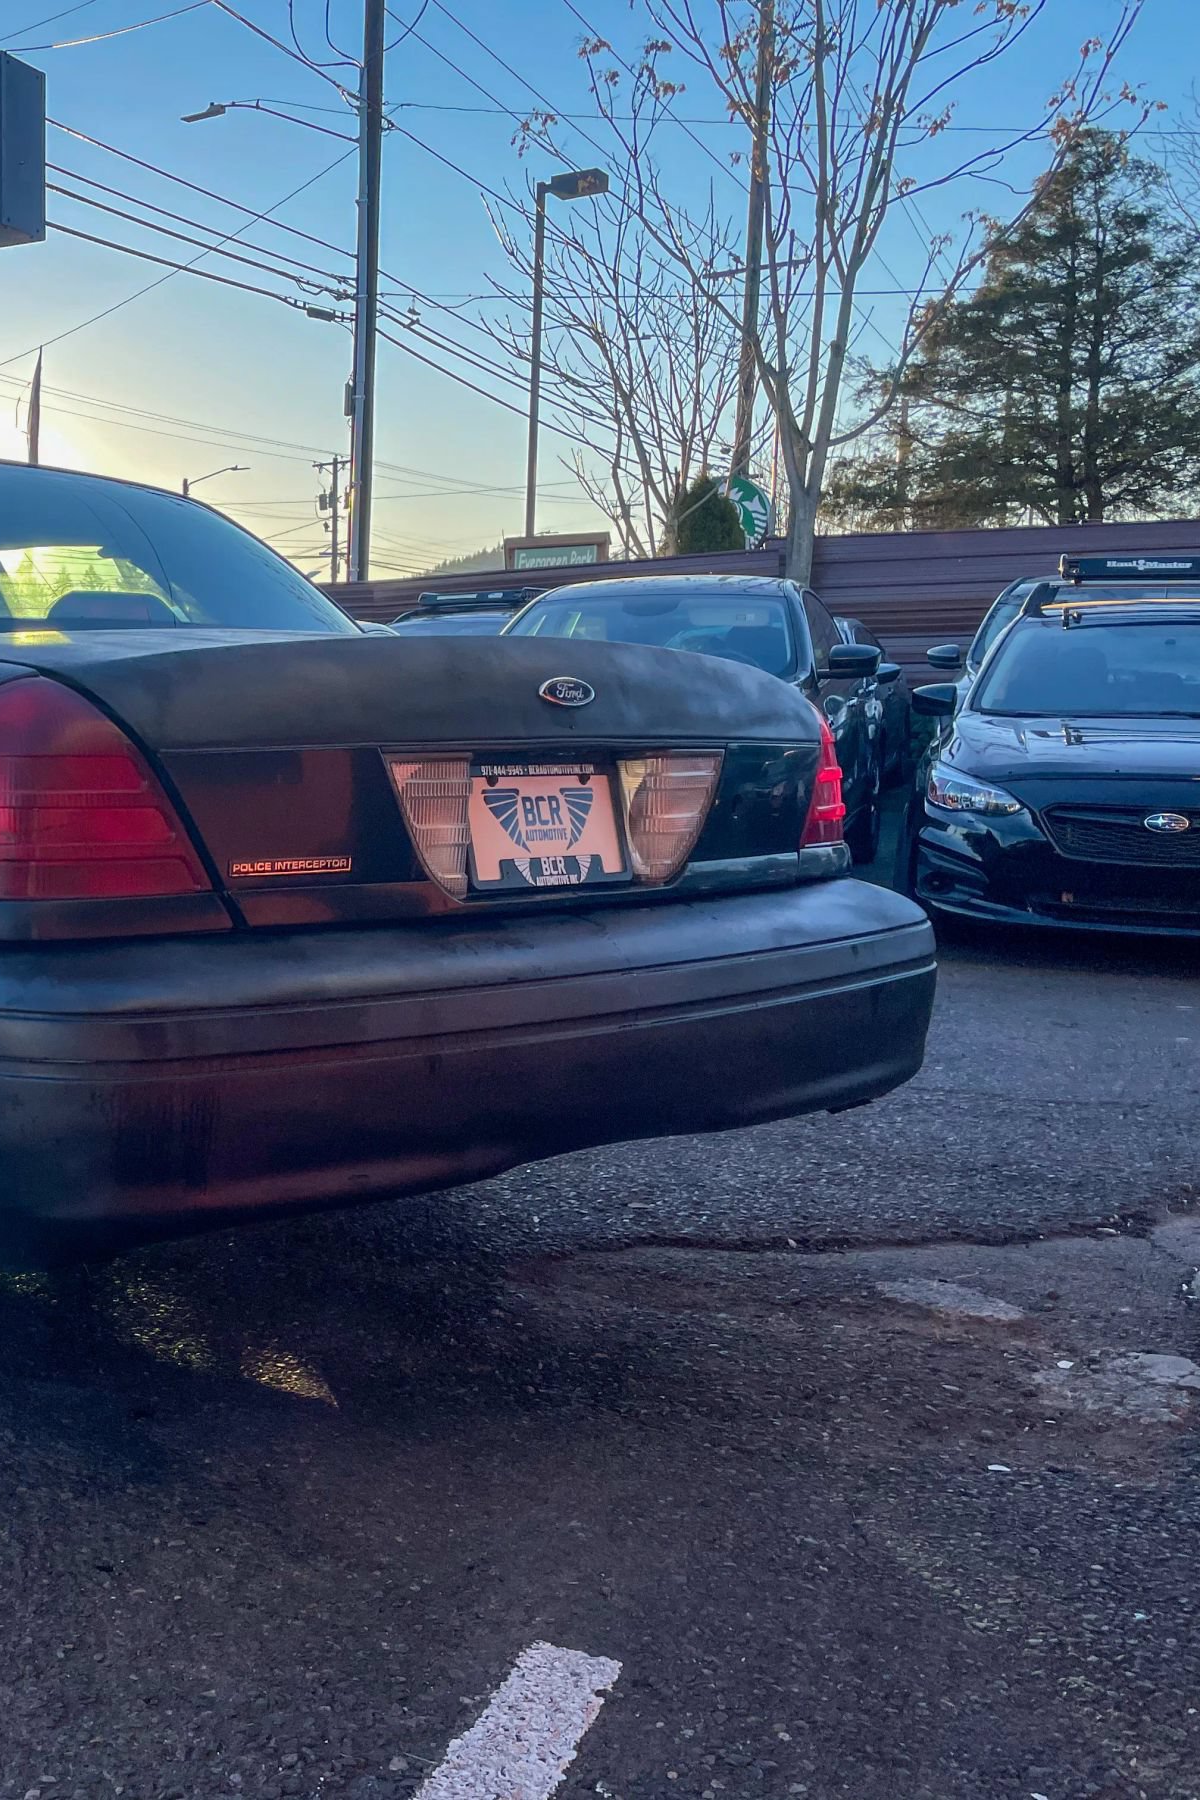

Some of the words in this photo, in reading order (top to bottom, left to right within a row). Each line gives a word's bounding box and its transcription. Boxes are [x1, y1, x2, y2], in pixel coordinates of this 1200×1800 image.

[556, 682, 584, 700] Ford
[521, 796, 563, 826] BCR
[526, 828, 568, 841] AUTOMOTIVE
[232, 862, 272, 873] POLICE
[274, 858, 347, 870] INTERCEPTOR
[540, 857, 567, 875] BCR
[536, 875, 569, 887] AUTOMOTIVE
